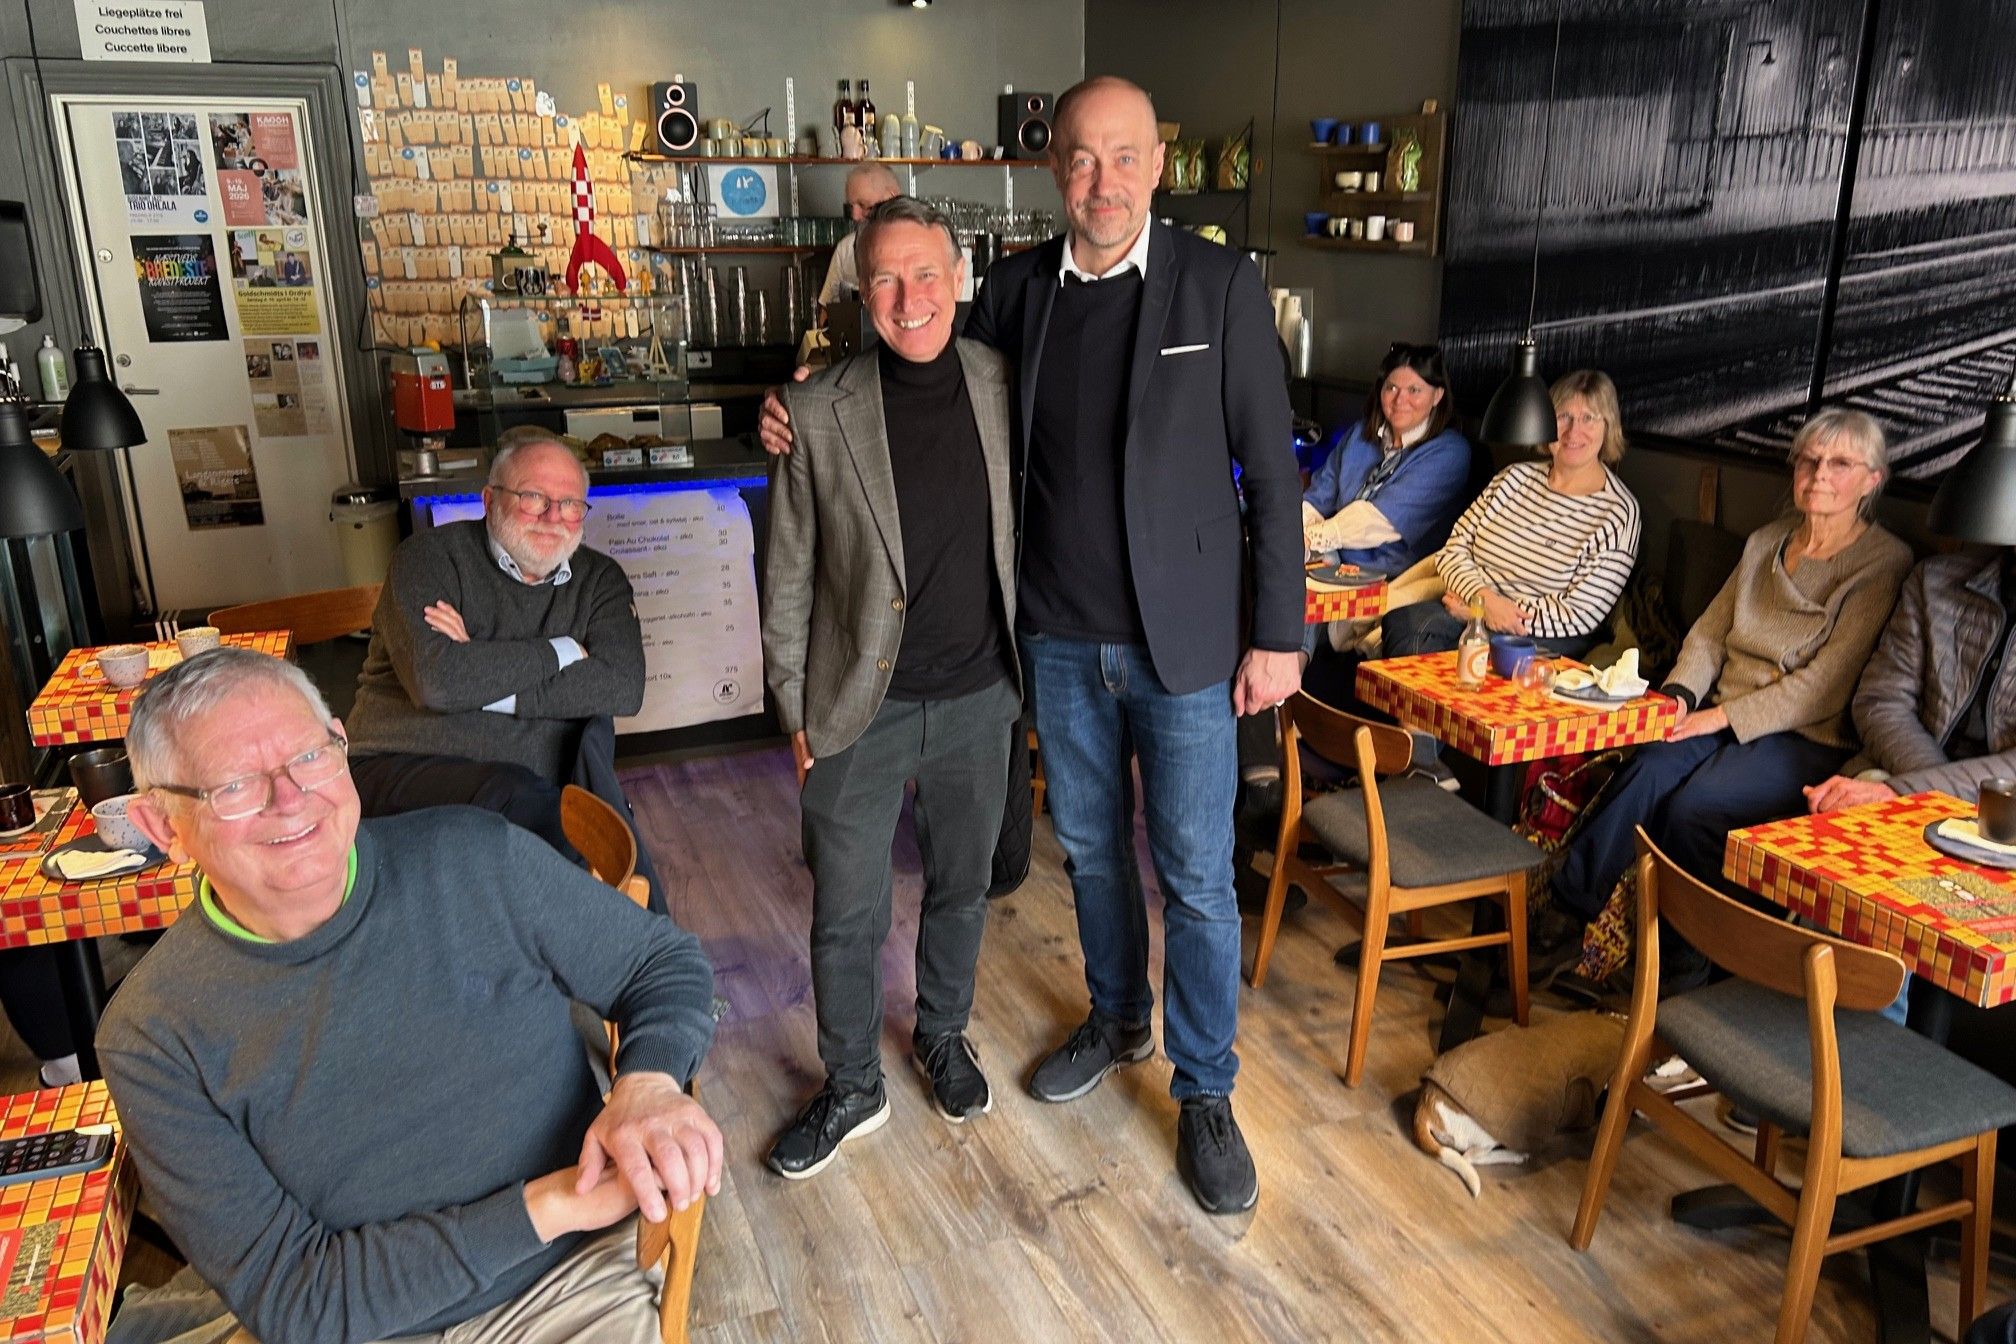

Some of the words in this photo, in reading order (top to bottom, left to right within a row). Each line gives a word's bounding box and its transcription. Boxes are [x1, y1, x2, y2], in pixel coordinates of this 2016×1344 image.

[98, 7, 162, 19] Liegeplätze
[165, 8, 183, 19] frei
[95, 24, 158, 36] Couchettes
[161, 25, 191, 37] libres
[104, 42, 154, 53] Cuccette
[157, 43, 187, 54] libere
[227, 183, 248, 192] MAJ
[129, 200, 146, 211] TRIO
[147, 200, 177, 211] OHLALA
[145, 260, 209, 279] BREDESTE
[608, 537, 625, 546] Pain
[609, 545, 648, 555] Croissant
